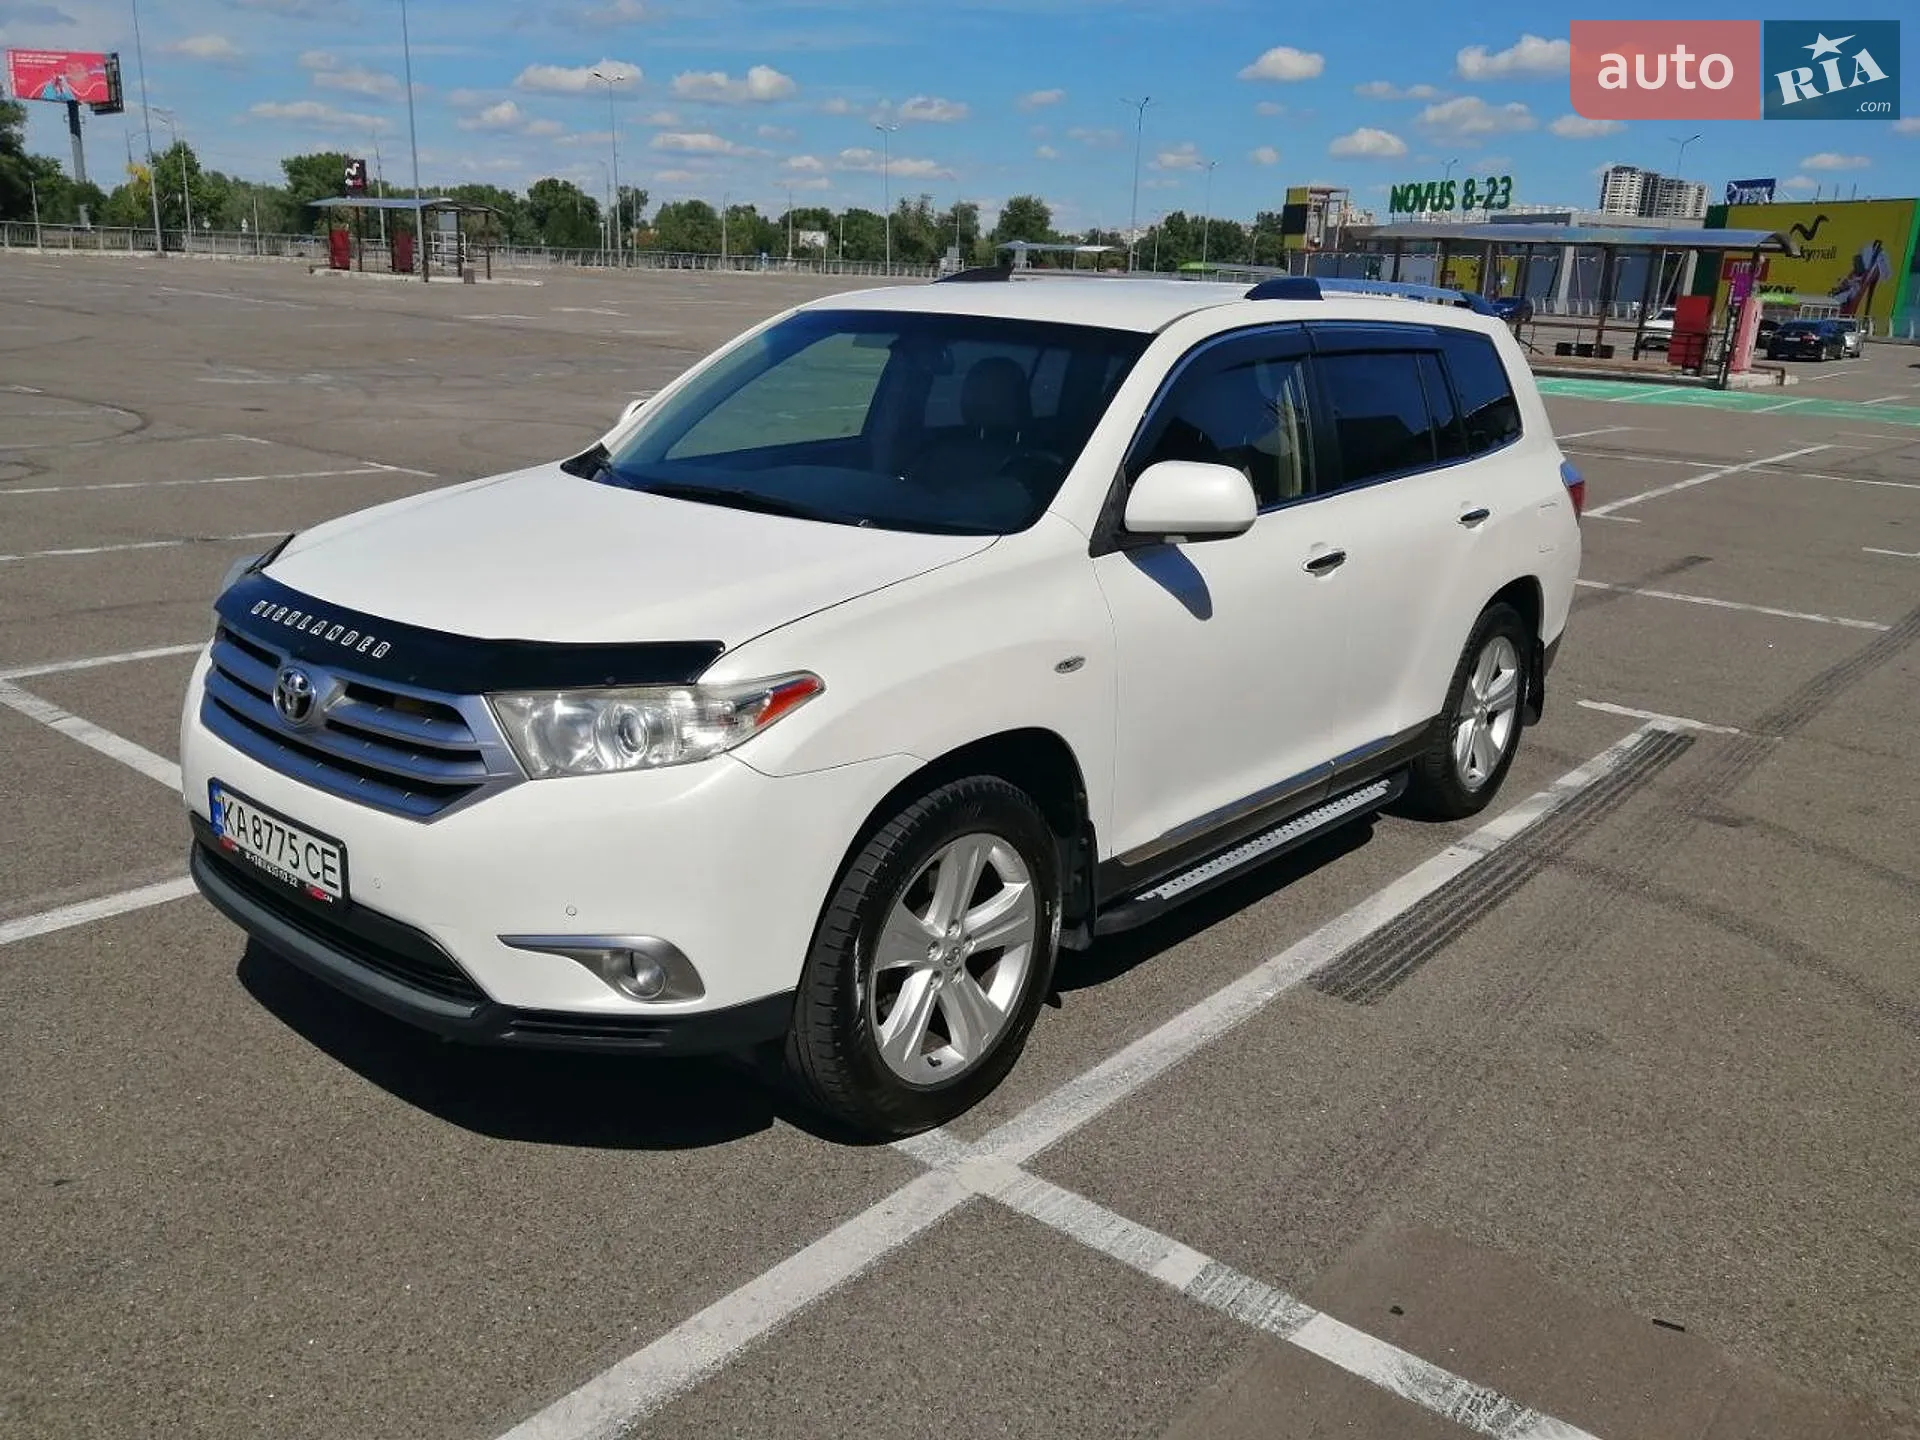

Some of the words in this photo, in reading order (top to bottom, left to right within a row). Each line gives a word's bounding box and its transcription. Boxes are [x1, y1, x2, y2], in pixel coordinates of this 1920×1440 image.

[1389, 180, 1456, 213] NOVUS
[1462, 175, 1512, 210] 8-23
[251, 600, 391, 659] HIGHLANDER
[222, 796, 249, 843] KA
[252, 814, 300, 870] 8775
[305, 841, 339, 890] CE
